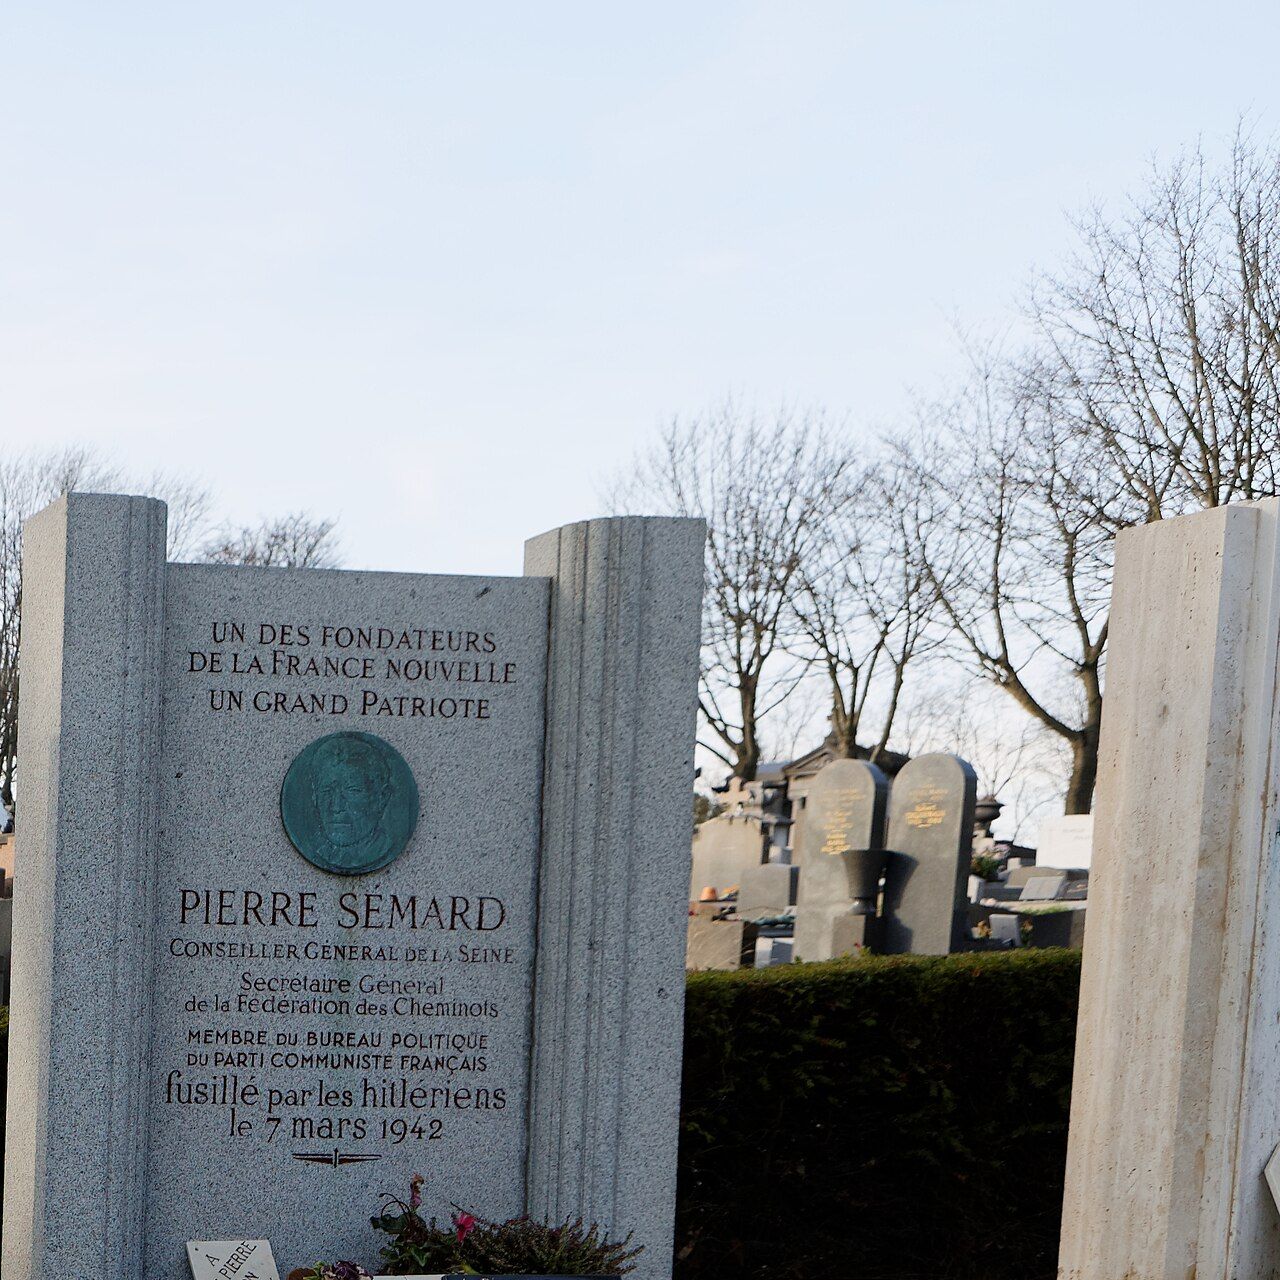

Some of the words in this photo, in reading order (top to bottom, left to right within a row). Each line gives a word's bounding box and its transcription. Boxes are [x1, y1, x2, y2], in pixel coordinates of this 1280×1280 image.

[212, 622, 245, 644] UN
[260, 624, 310, 646] DES
[322, 627, 498, 654] FONDATEURS
[189, 651, 223, 673] DE
[231, 652, 264, 674] LA
[272, 650, 376, 679] FRANCE
[387, 658, 518, 684] NOUVELLE
[209, 689, 243, 711] UN
[253, 691, 348, 716] GRAND
[362, 690, 491, 719] PATRIOTE
[179, 889, 318, 928] PIERRE
[338, 883, 507, 931] SÉMARD
[241, 972, 350, 994] Secrétaire
[184, 995, 208, 1012] de
[215, 995, 230, 1012] la
[356, 999, 388, 1016] des
[393, 997, 499, 1018] Cheminots
[188, 1030, 267, 1045] MEMBRE
[276, 1033, 298, 1046] DU
[307, 1031, 382, 1048] BUREAU
[391, 1032, 488, 1051] POLITIQUE
[187, 1052, 208, 1066] DU
[214, 1052, 264, 1068] PARTI
[270, 1052, 392, 1070] COMMUNISTE
[400, 1055, 488, 1075] FRANÇAIS
[166, 1070, 259, 1106] fusillé
[267, 1088, 317, 1113] par
[318, 1080, 353, 1107] les
[362, 1077, 507, 1110] hitlériens
[229, 1108, 252, 1137] le
[267, 1117, 281, 1143] 7
[292, 1116, 367, 1140] mars
[381, 1118, 443, 1144] 1942
[205, 1253, 220, 1267] A
[219, 1240, 257, 1280] PIERRE
